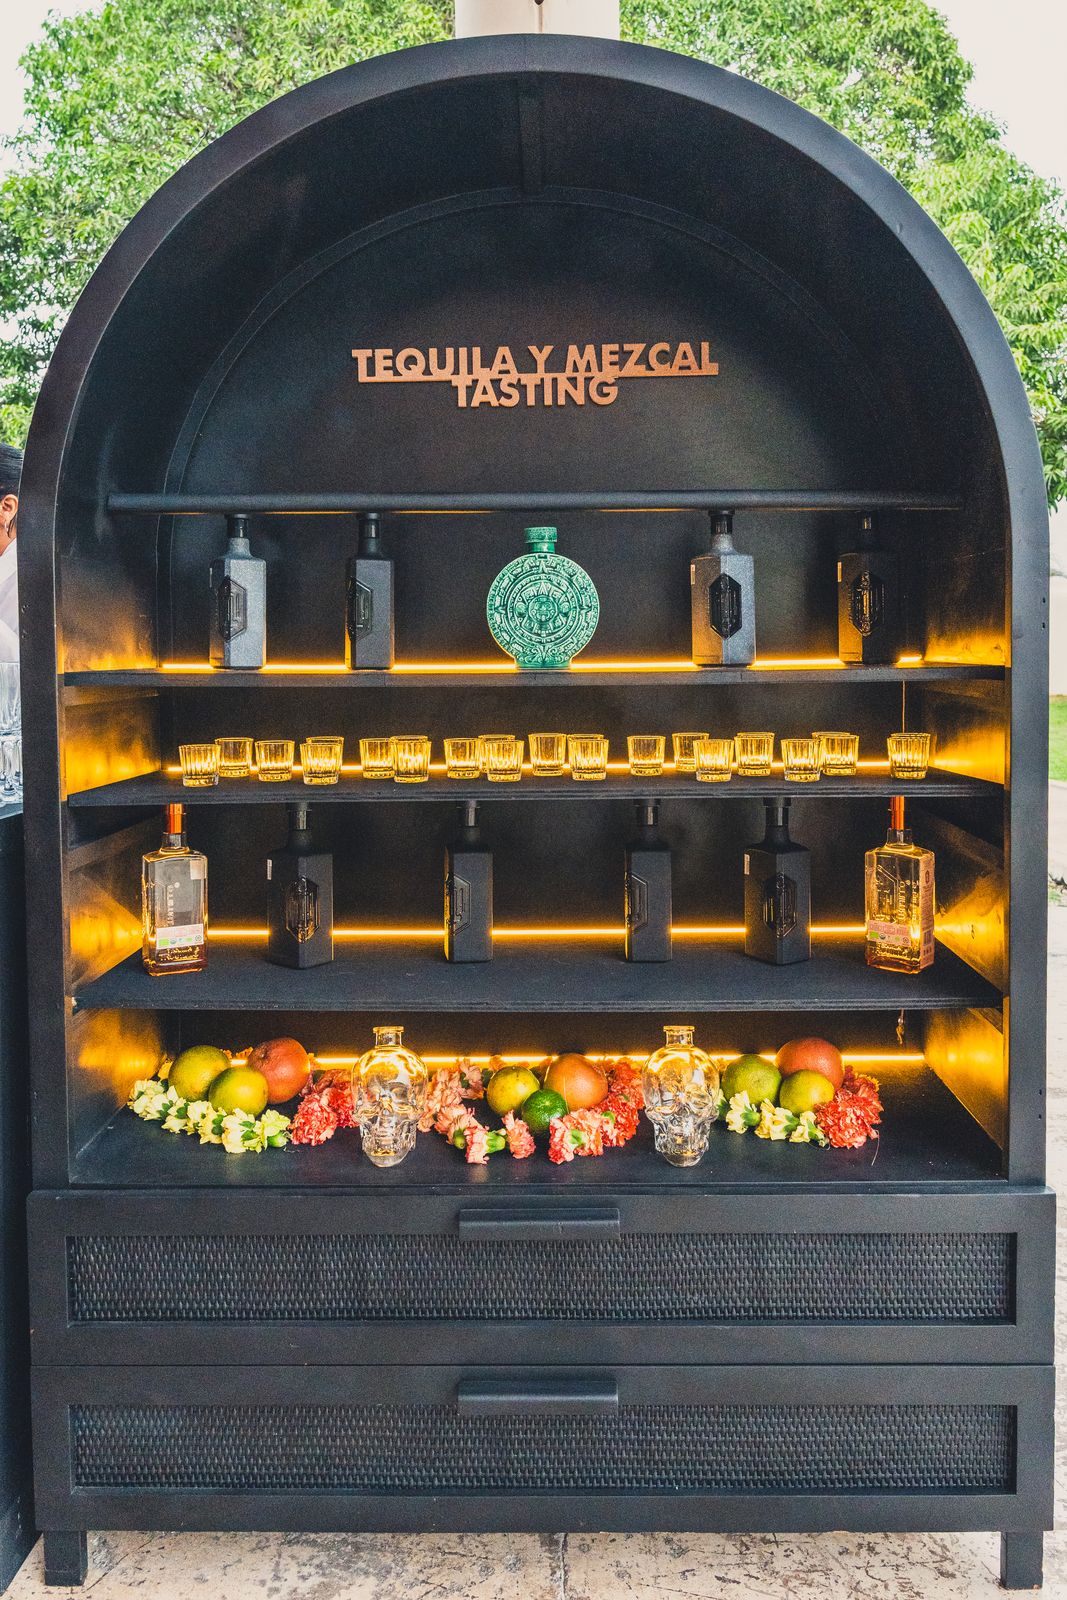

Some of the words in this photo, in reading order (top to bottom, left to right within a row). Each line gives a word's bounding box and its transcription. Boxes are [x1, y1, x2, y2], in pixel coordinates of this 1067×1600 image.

[352, 346, 518, 379] TEQUILA
[527, 345, 554, 376] Y
[565, 341, 719, 376] MEZCAL
[451, 374, 619, 407] TASTING
